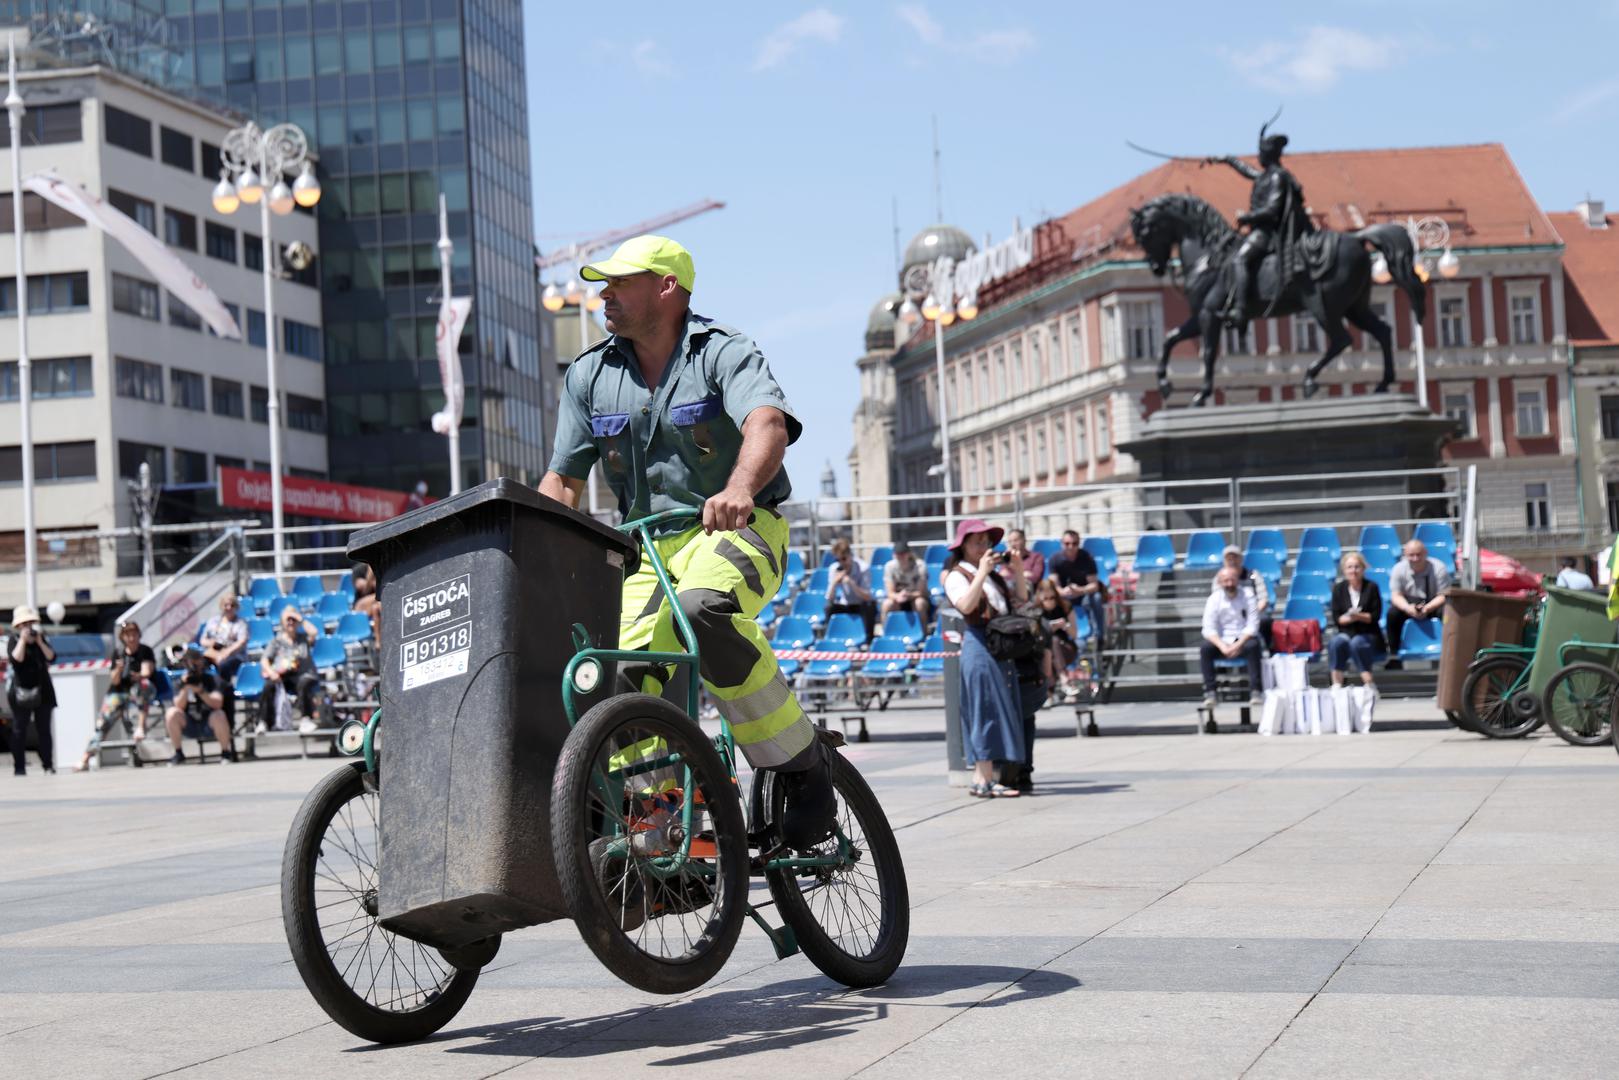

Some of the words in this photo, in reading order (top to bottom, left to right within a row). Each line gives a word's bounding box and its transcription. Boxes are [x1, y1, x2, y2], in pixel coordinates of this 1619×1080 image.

[404, 581, 469, 618] ČISTOĆA
[420, 608, 451, 626] ZAGREB
[419, 628, 468, 660] 91318
